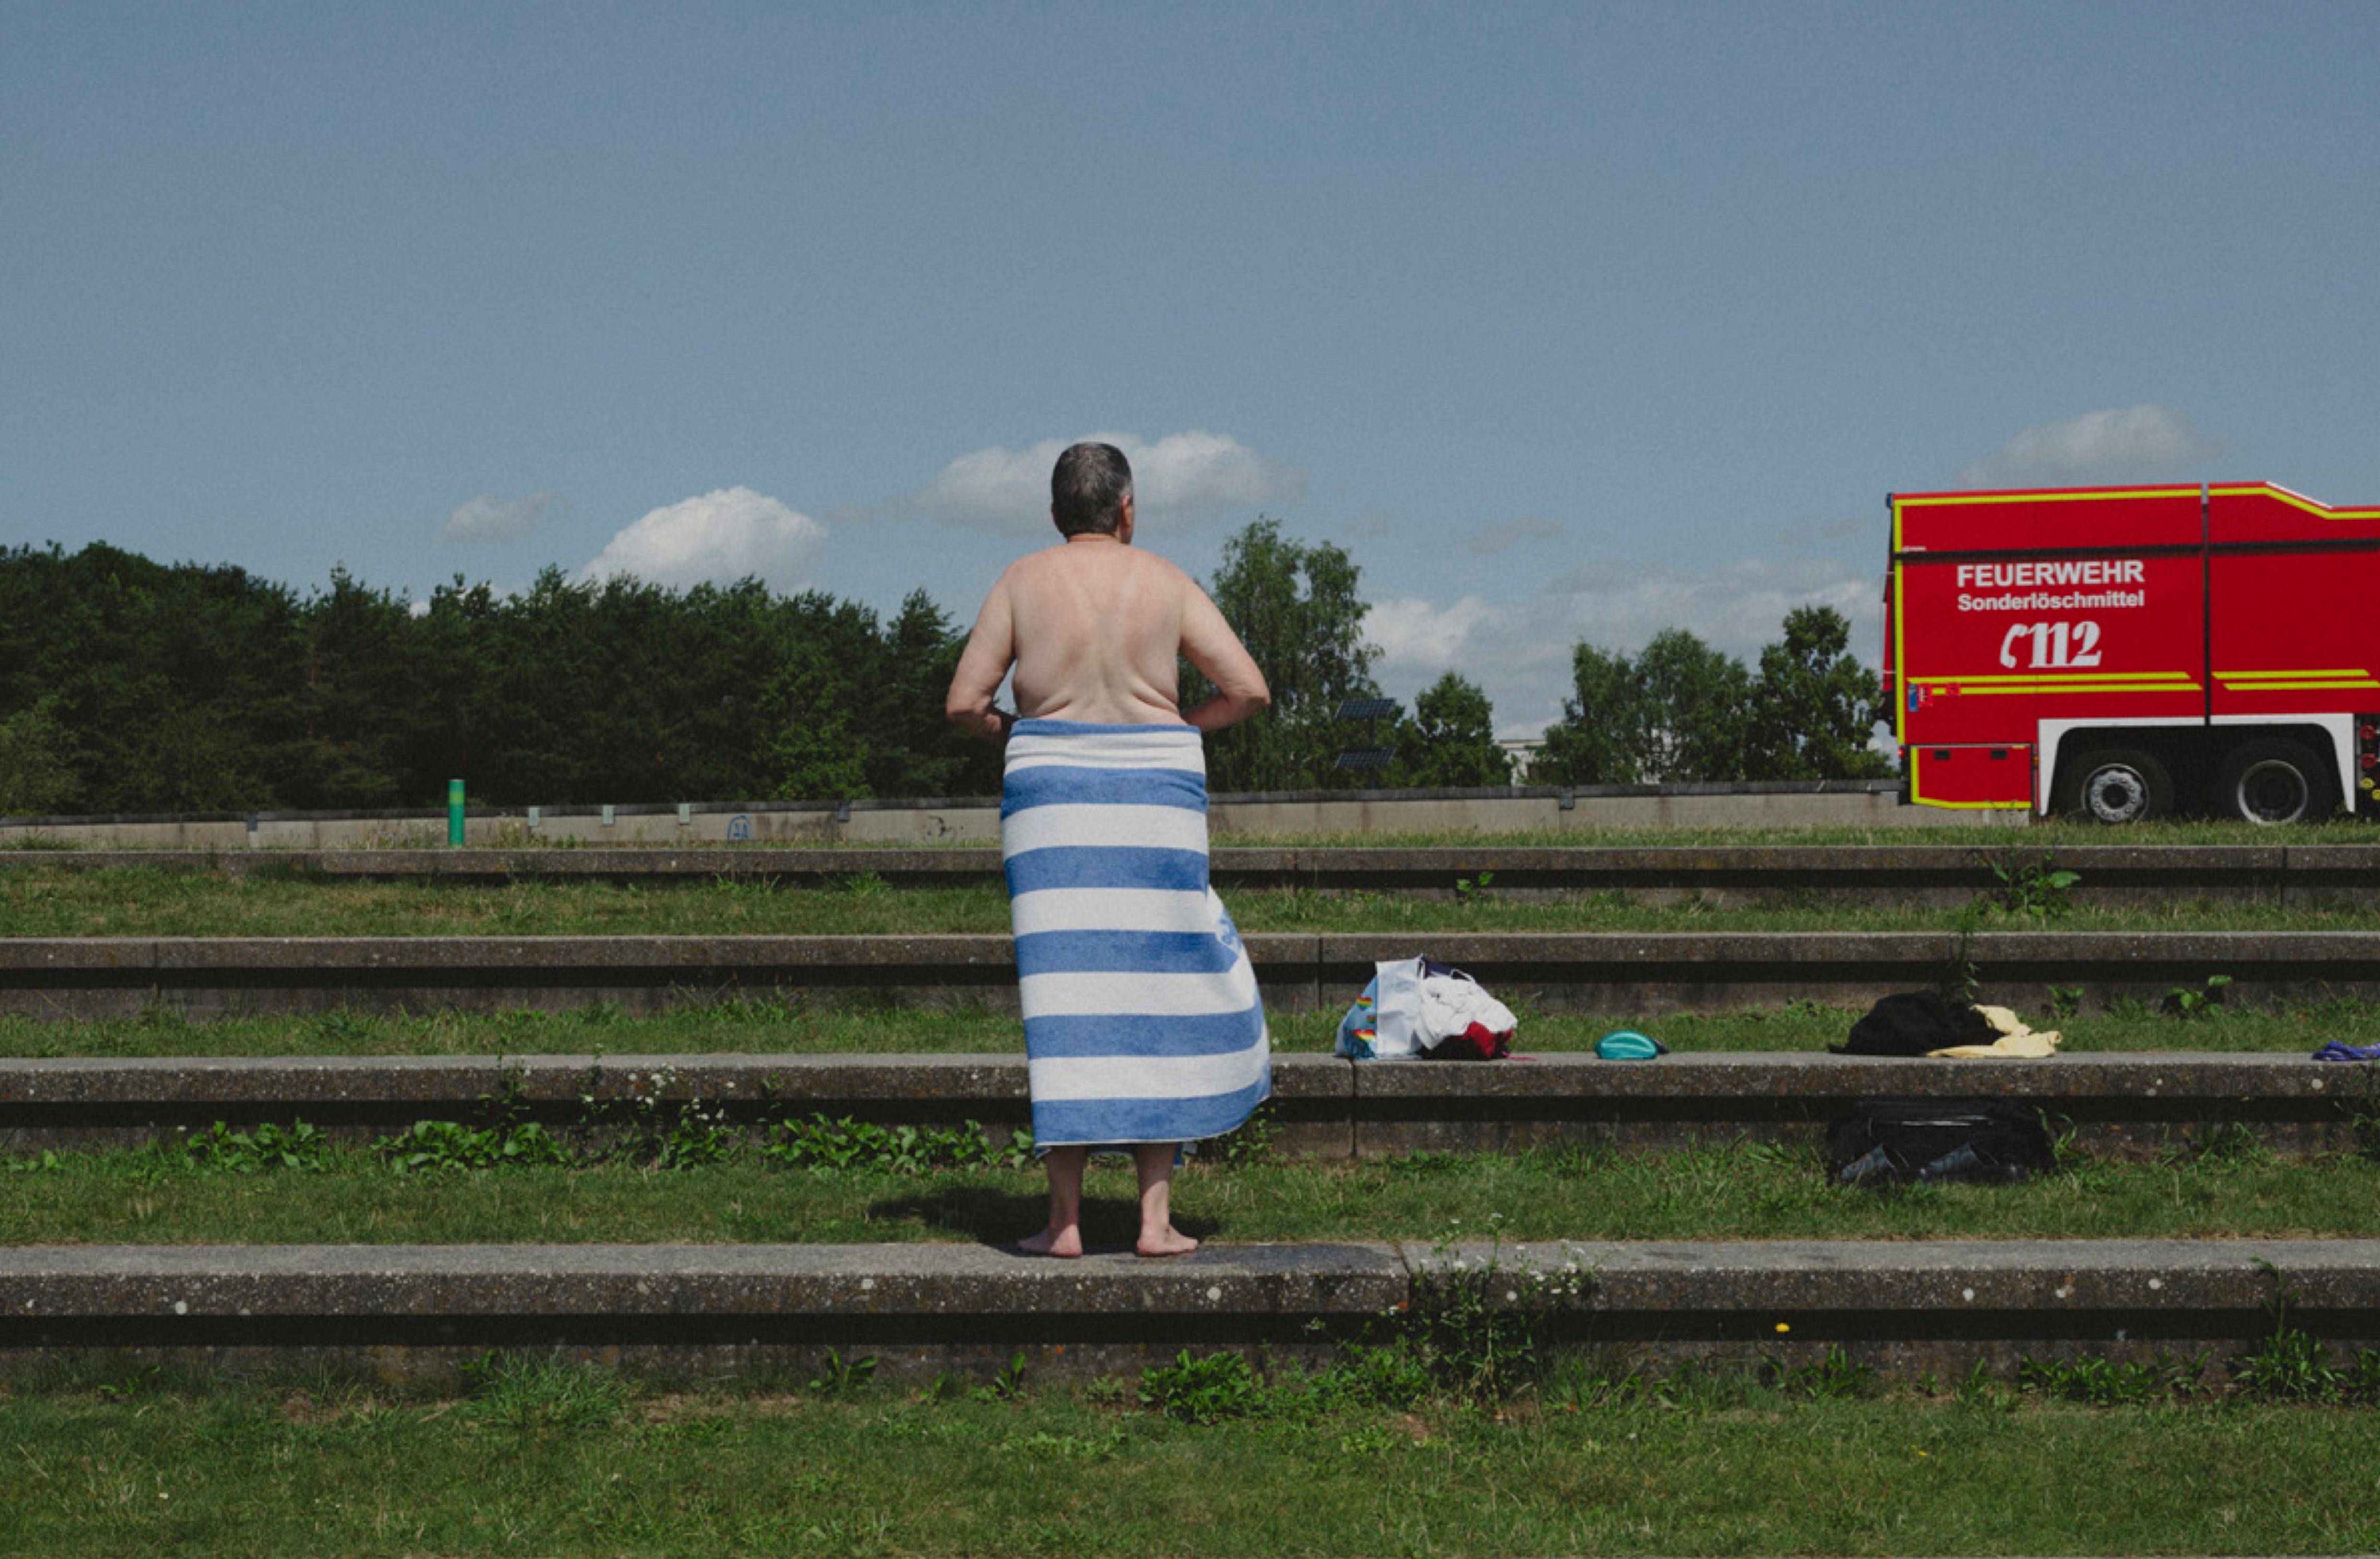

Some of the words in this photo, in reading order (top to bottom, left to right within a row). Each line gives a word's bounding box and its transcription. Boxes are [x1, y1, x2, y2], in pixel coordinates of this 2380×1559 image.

[1957, 560, 2145, 587] FEUERWEHR
[1957, 589, 2144, 611] Sonderlöschmittel
[2027, 621, 2102, 668] 112
